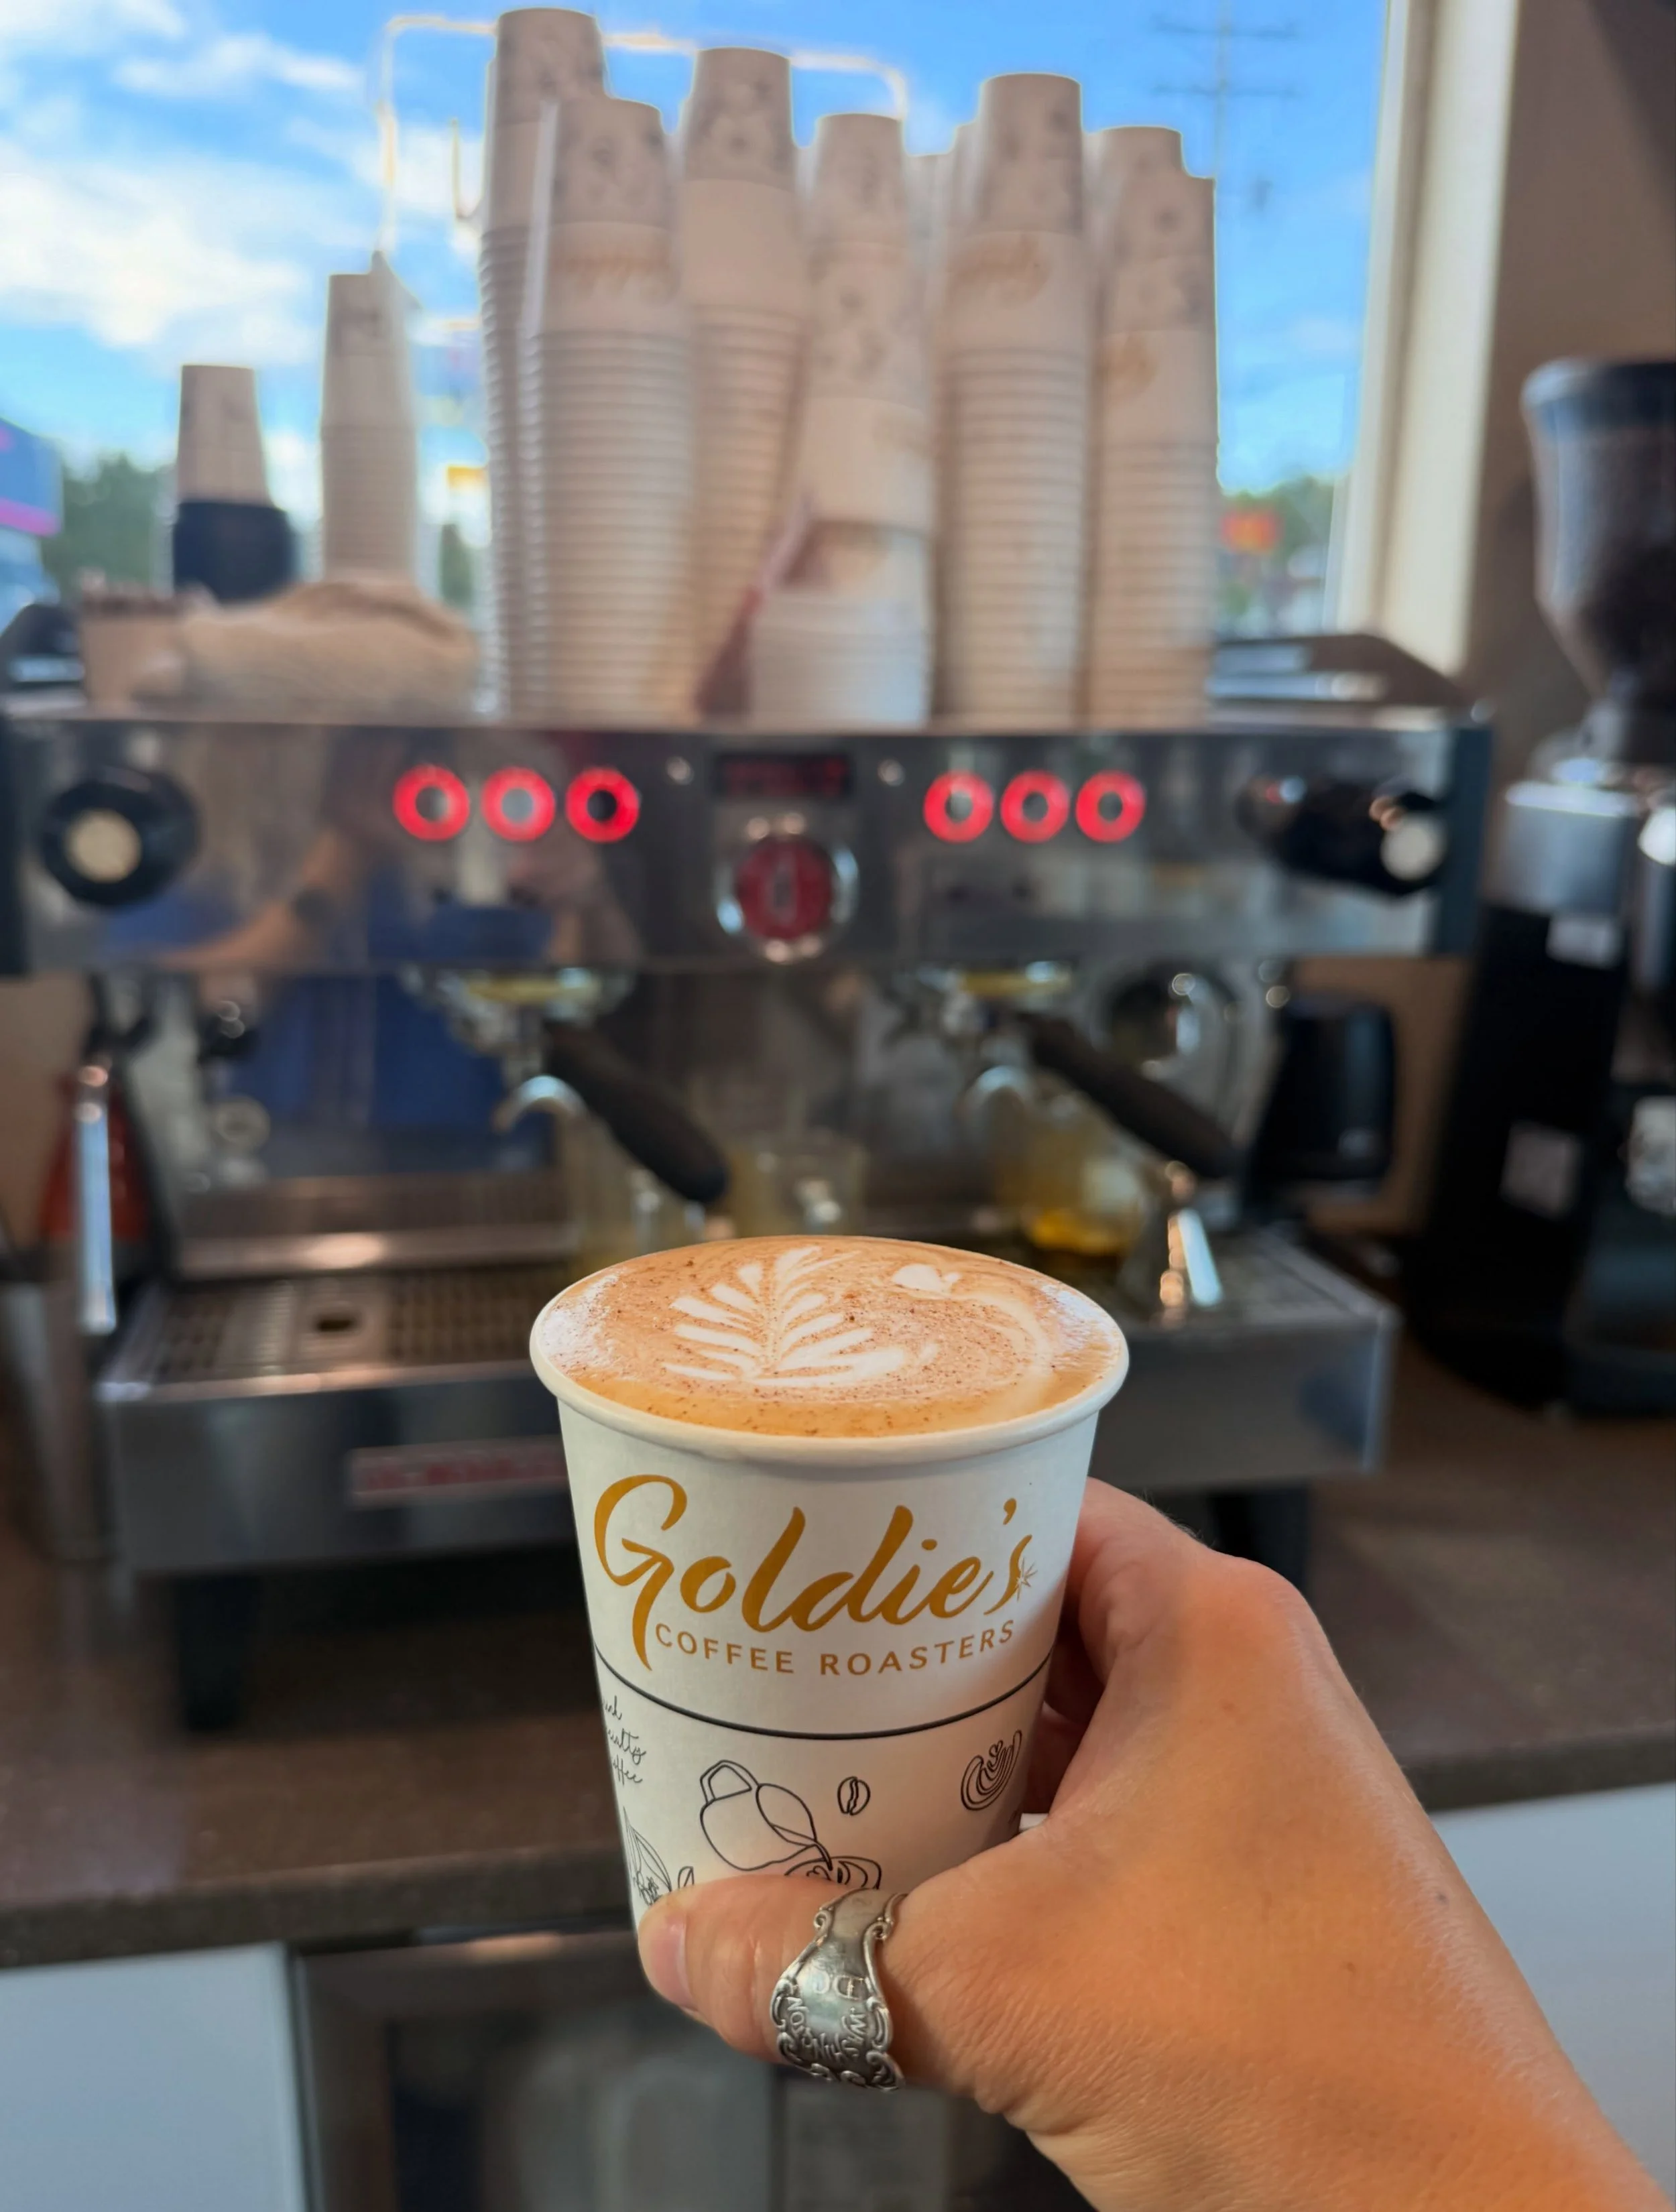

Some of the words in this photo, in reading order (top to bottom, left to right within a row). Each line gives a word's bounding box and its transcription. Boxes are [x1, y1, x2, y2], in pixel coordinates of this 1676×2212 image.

[593, 1474, 1033, 1672] Goldie's
[655, 1622, 794, 1674] COFFEE
[820, 1619, 1014, 1676] ROASTERS
